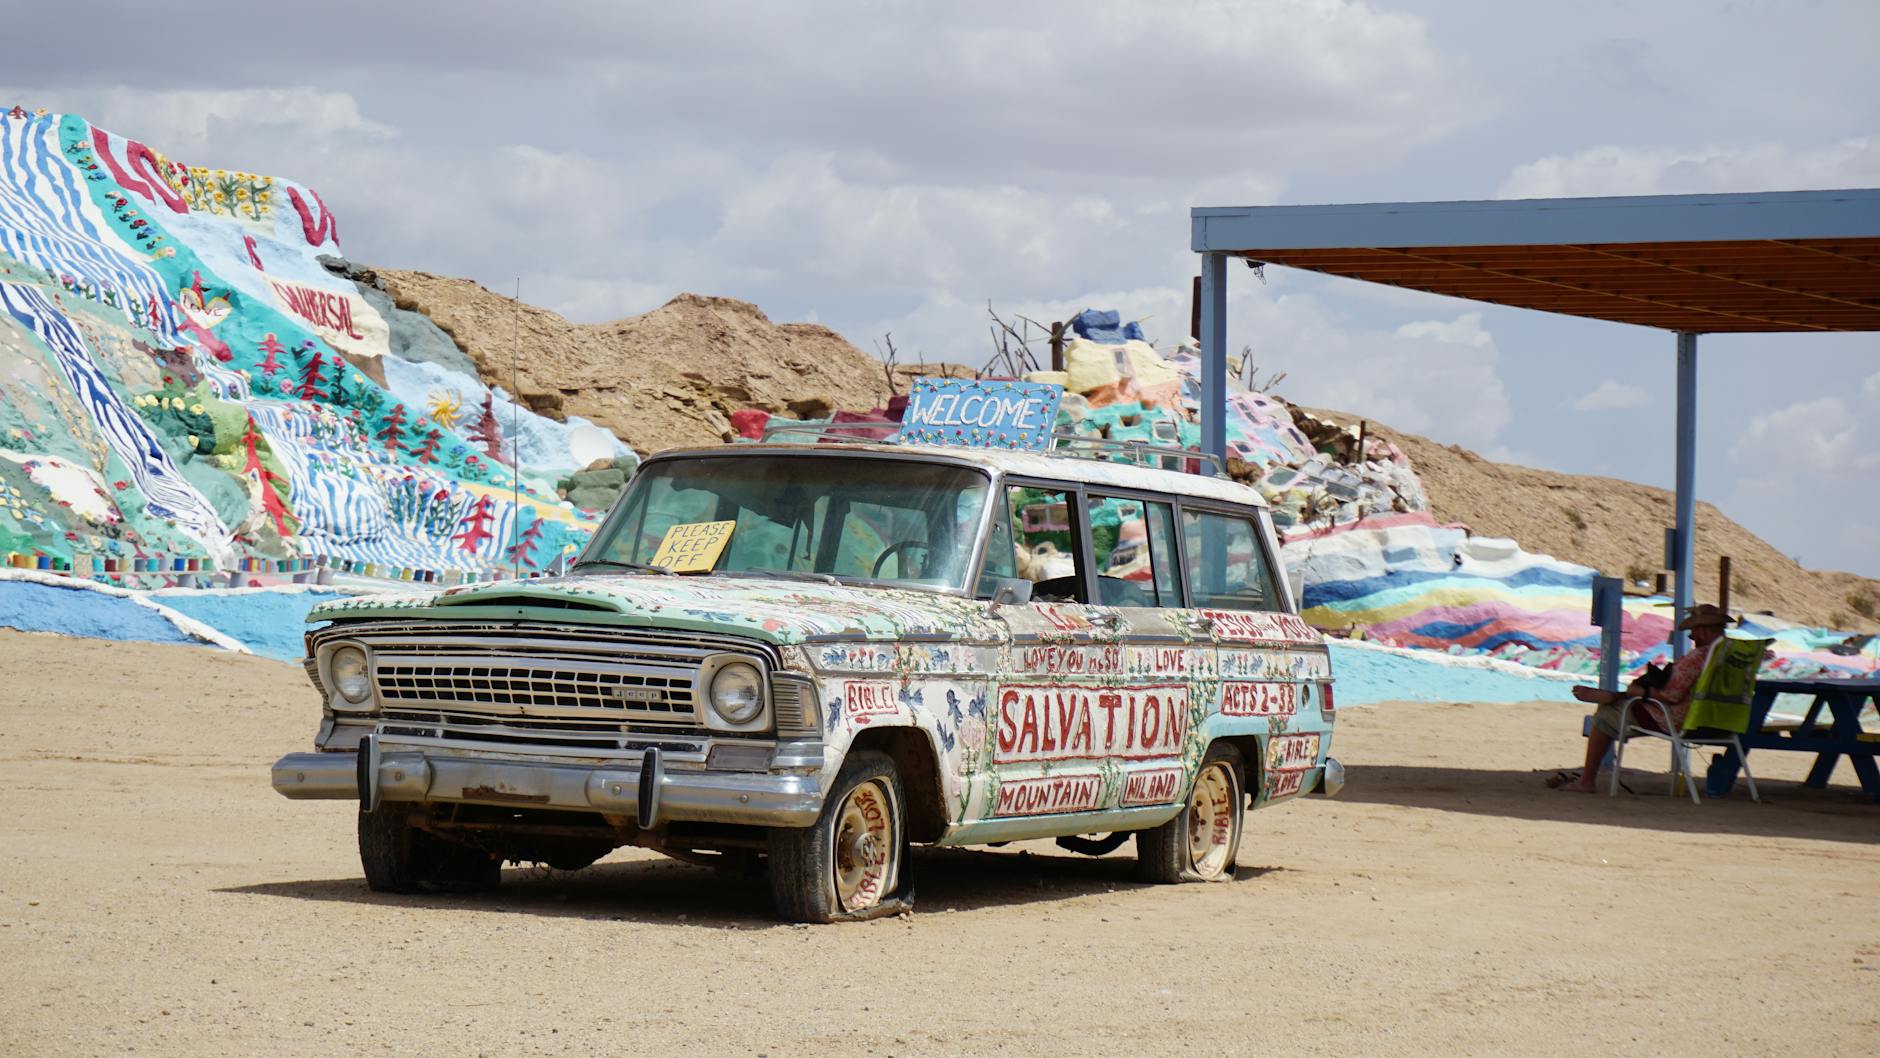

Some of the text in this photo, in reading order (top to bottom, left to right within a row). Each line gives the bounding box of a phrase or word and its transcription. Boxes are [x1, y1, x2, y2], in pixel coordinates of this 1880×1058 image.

[911, 394, 1042, 429] WELCOME
[671, 523, 729, 539] PLEASE
[668, 537, 719, 554] KEEP
[657, 554, 704, 569] OFF
[1202, 612, 1264, 638] JESUS
[1269, 615, 1312, 640] YOU
[1057, 647, 1083, 672] YOU
[614, 690, 659, 700] Jeep
[847, 684, 894, 712] BIBLE
[1224, 683, 1294, 712] ACTS 2-38
[1000, 690, 1185, 753] SALVATION
[997, 780, 1094, 813] MOUNTAIN
